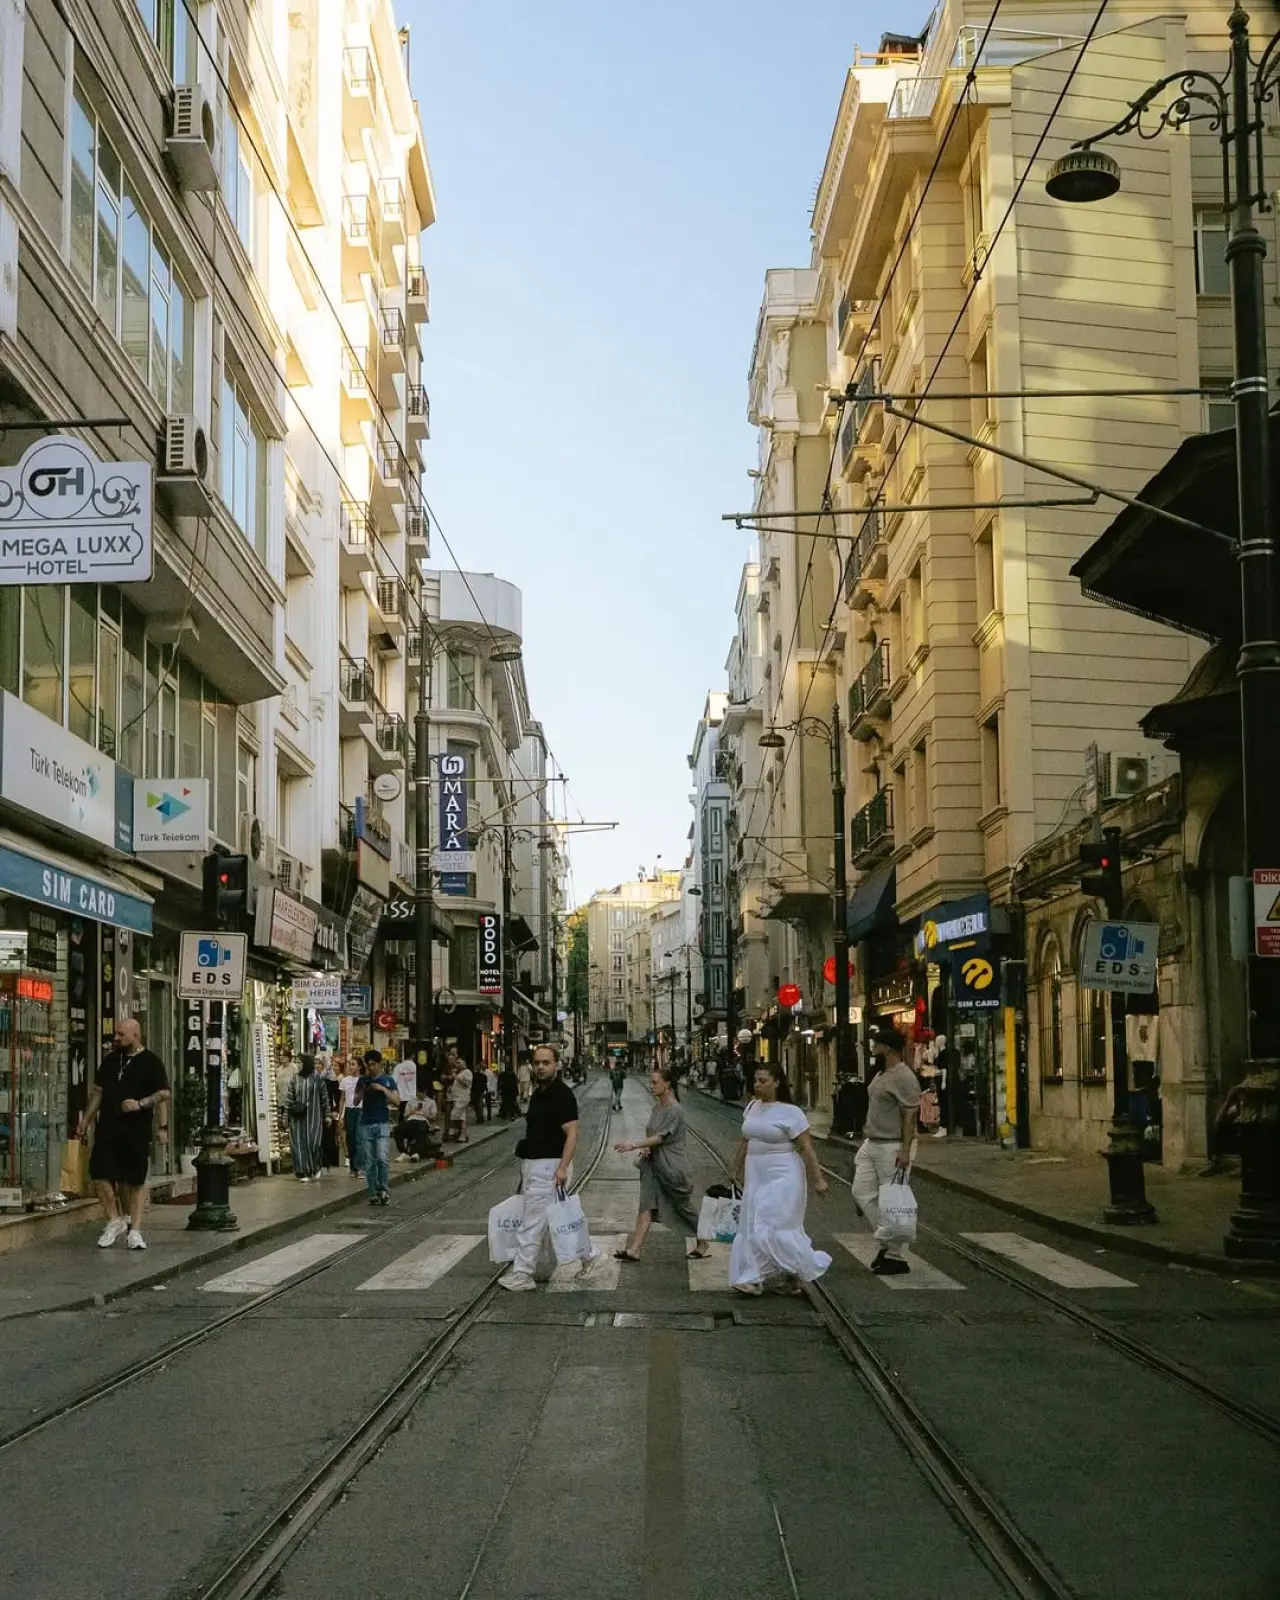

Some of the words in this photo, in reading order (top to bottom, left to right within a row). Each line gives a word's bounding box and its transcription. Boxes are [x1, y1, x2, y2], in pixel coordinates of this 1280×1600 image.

[76, 535, 132, 554] LUXX
[26, 560, 88, 575] HOTEL
[30, 747, 50, 778] Türk
[52, 760, 87, 797] Telekom
[140, 833, 159, 842] Türk
[162, 832, 200, 842] Telekom
[42, 869, 71, 905] SIM
[79, 887, 115, 918] CARD
[485, 916, 496, 964] DODO
[1095, 961, 1140, 976] EDS
[192, 972, 231, 985] EDS
[295, 980, 310, 988] SIM
[313, 980, 339, 988] CARD
[310, 989, 338, 997] HERE
